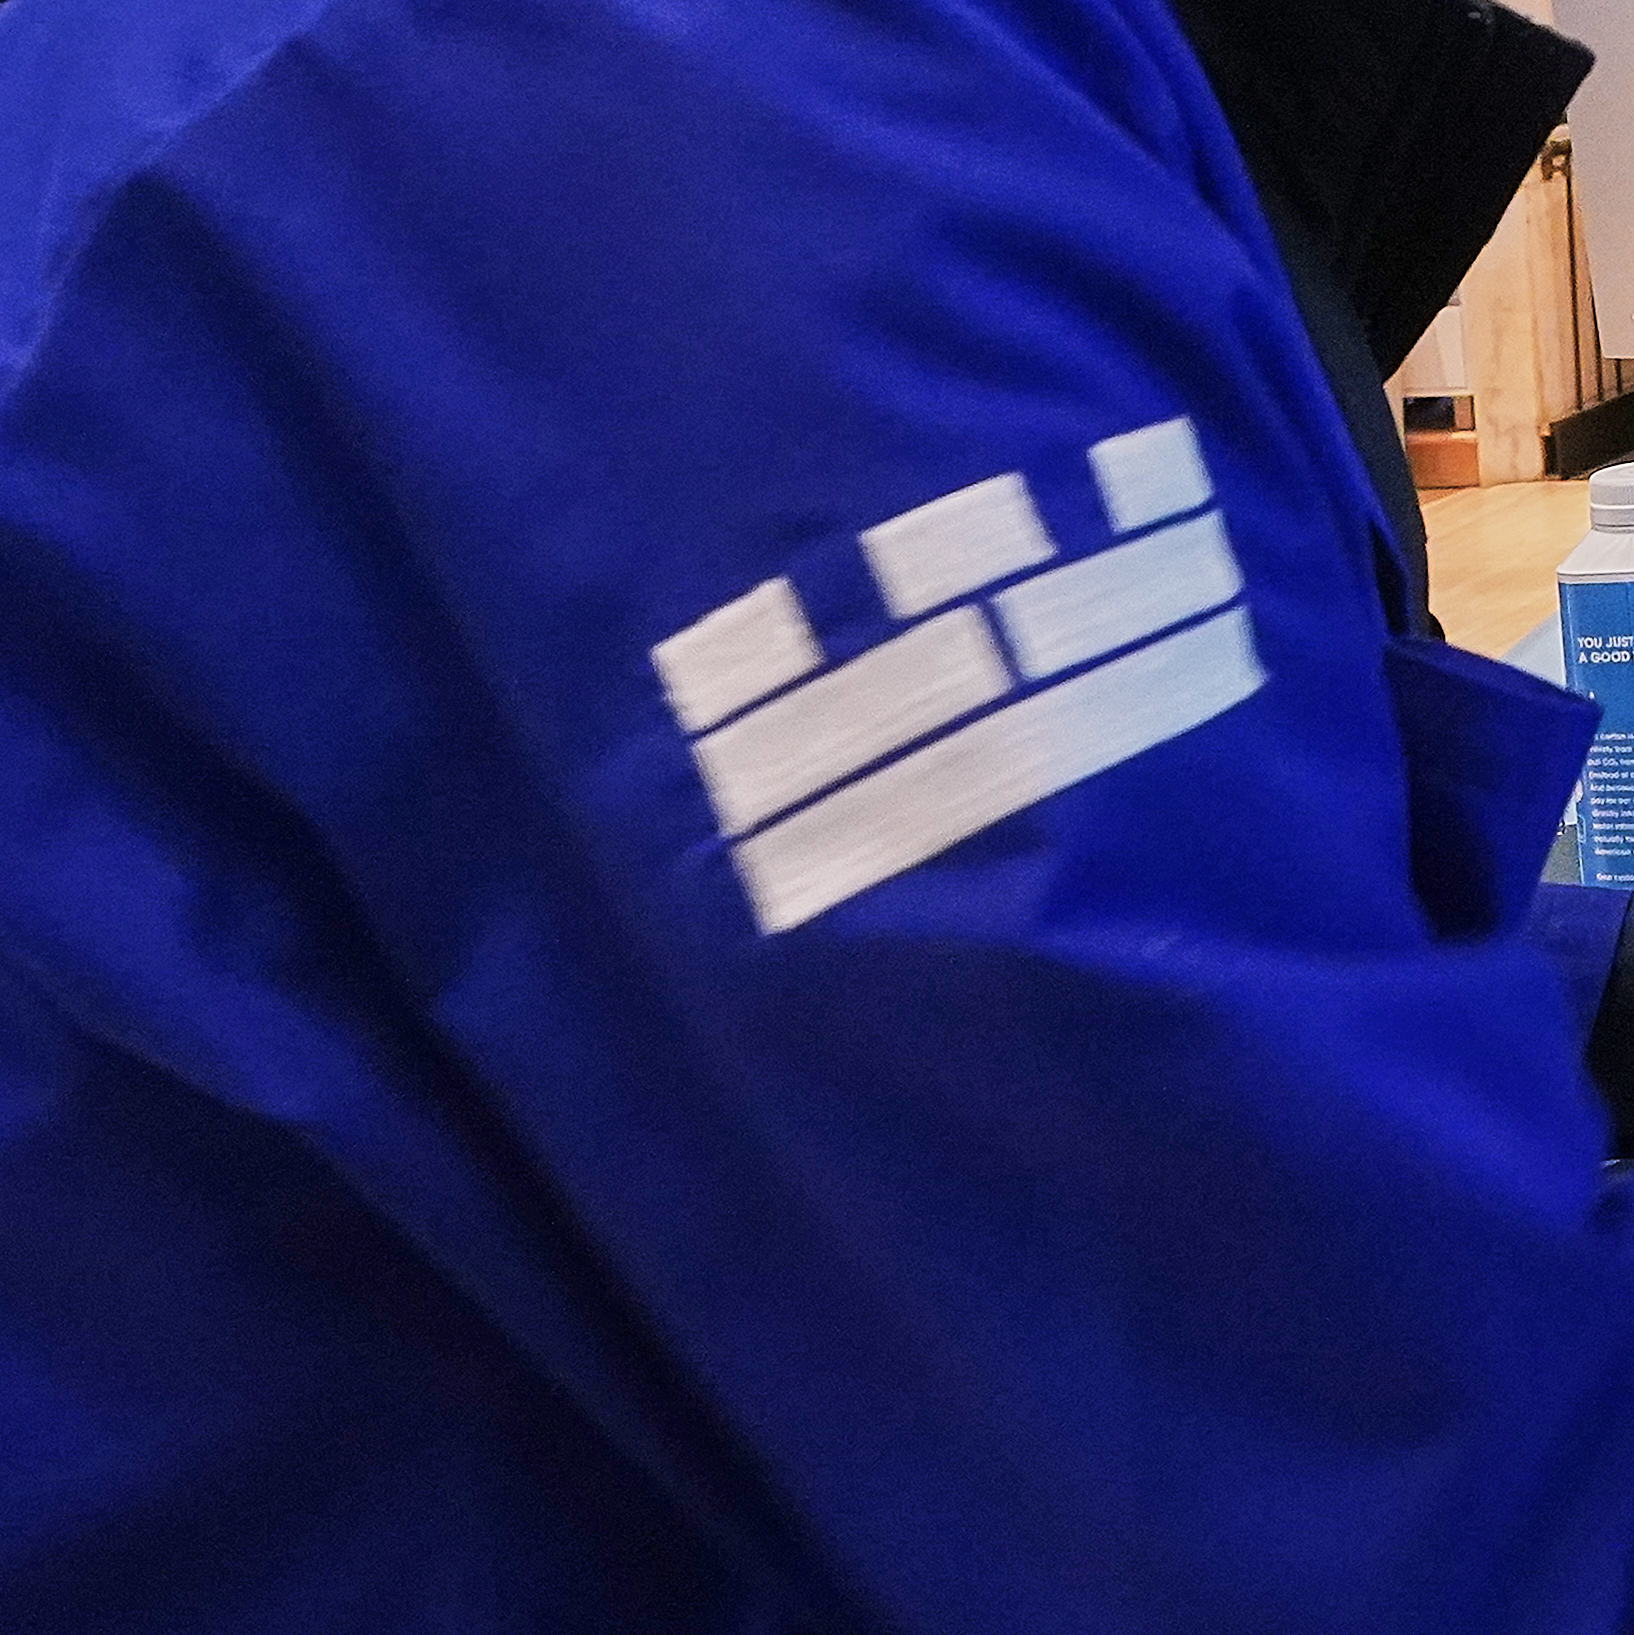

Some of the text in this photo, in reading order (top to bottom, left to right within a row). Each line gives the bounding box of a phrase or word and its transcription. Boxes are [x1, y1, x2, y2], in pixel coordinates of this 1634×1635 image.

[1578, 637, 1602, 649] YOU
[1605, 636, 1634, 648] JUST
[1578, 652, 1588, 664] A
[1590, 651, 1631, 664] GOOD
